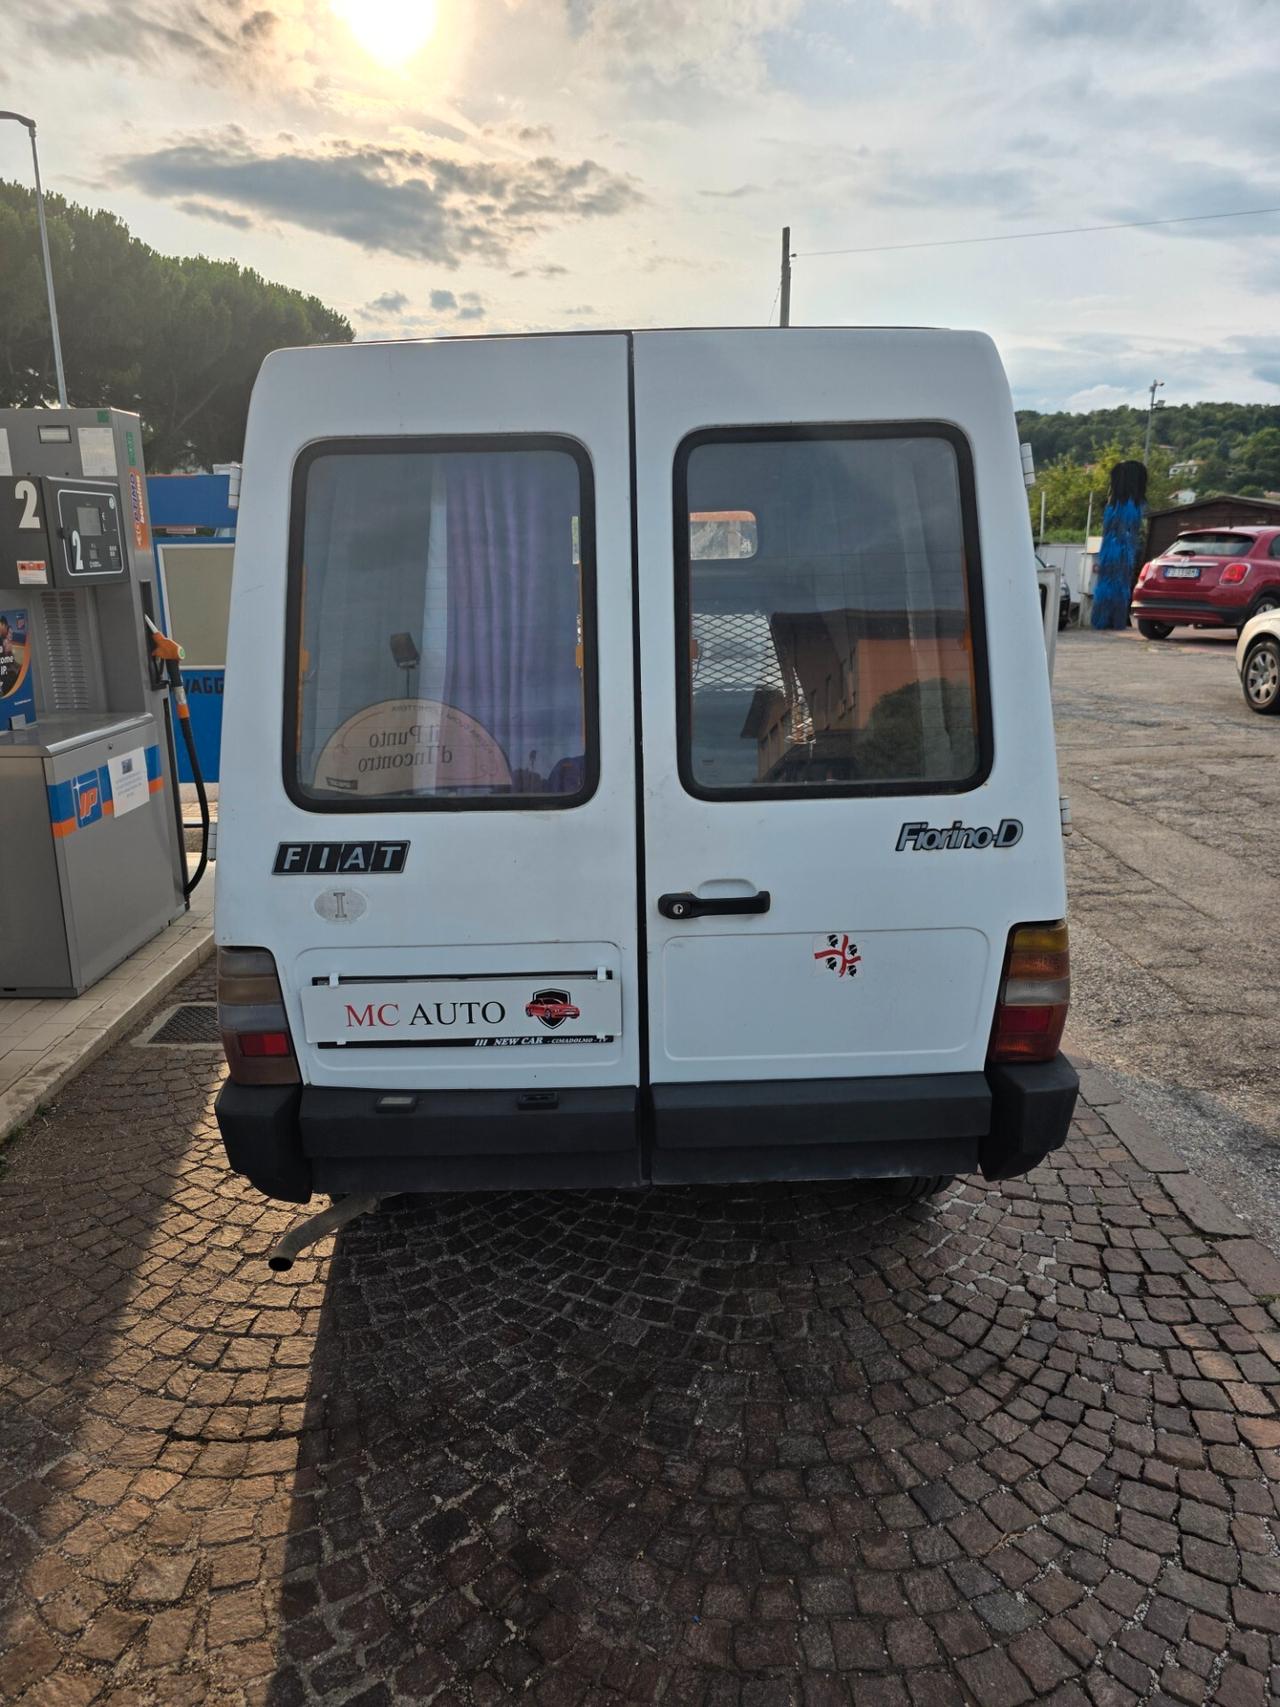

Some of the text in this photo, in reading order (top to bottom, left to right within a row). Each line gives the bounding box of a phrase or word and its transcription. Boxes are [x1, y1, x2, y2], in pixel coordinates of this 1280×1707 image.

[14, 480, 40, 529] 2
[71, 530, 84, 570] 2
[282, 846, 403, 870] FIAT
[345, 1001, 506, 1027] MC AUTO
[493, 1038, 520, 1046] NEW
[520, 1037, 545, 1045] CAR
